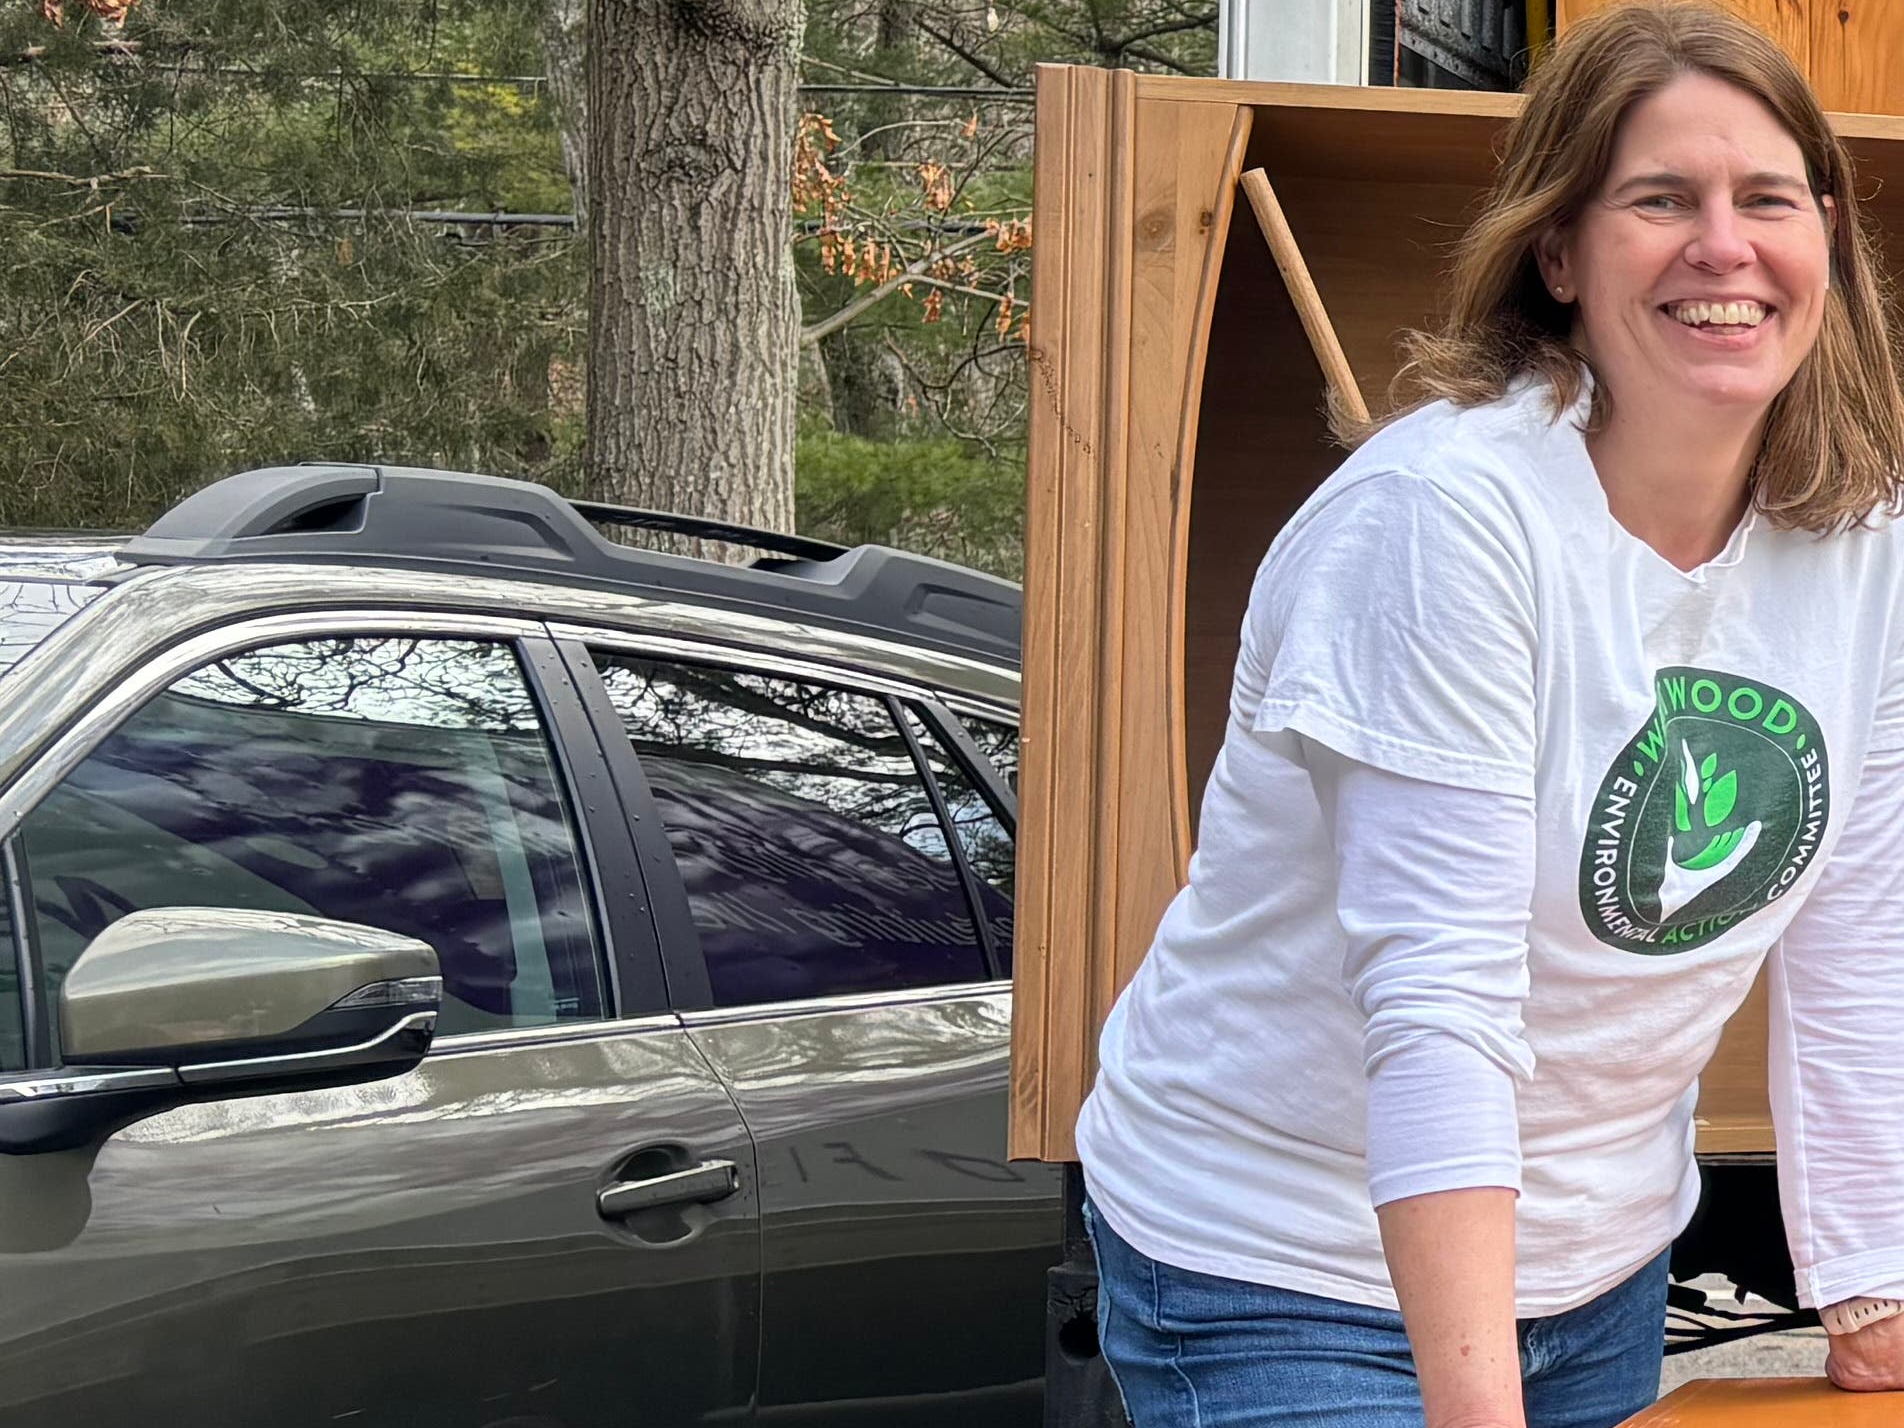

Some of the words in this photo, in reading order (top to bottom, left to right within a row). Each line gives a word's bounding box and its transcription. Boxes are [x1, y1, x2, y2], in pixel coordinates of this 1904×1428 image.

[1636, 676, 1798, 763] WWOOD
[1592, 776, 1662, 944] ENVIRONMENTAL
[1660, 902, 1758, 944] ACTIO
[1766, 748, 1823, 901] COMMITTEE
